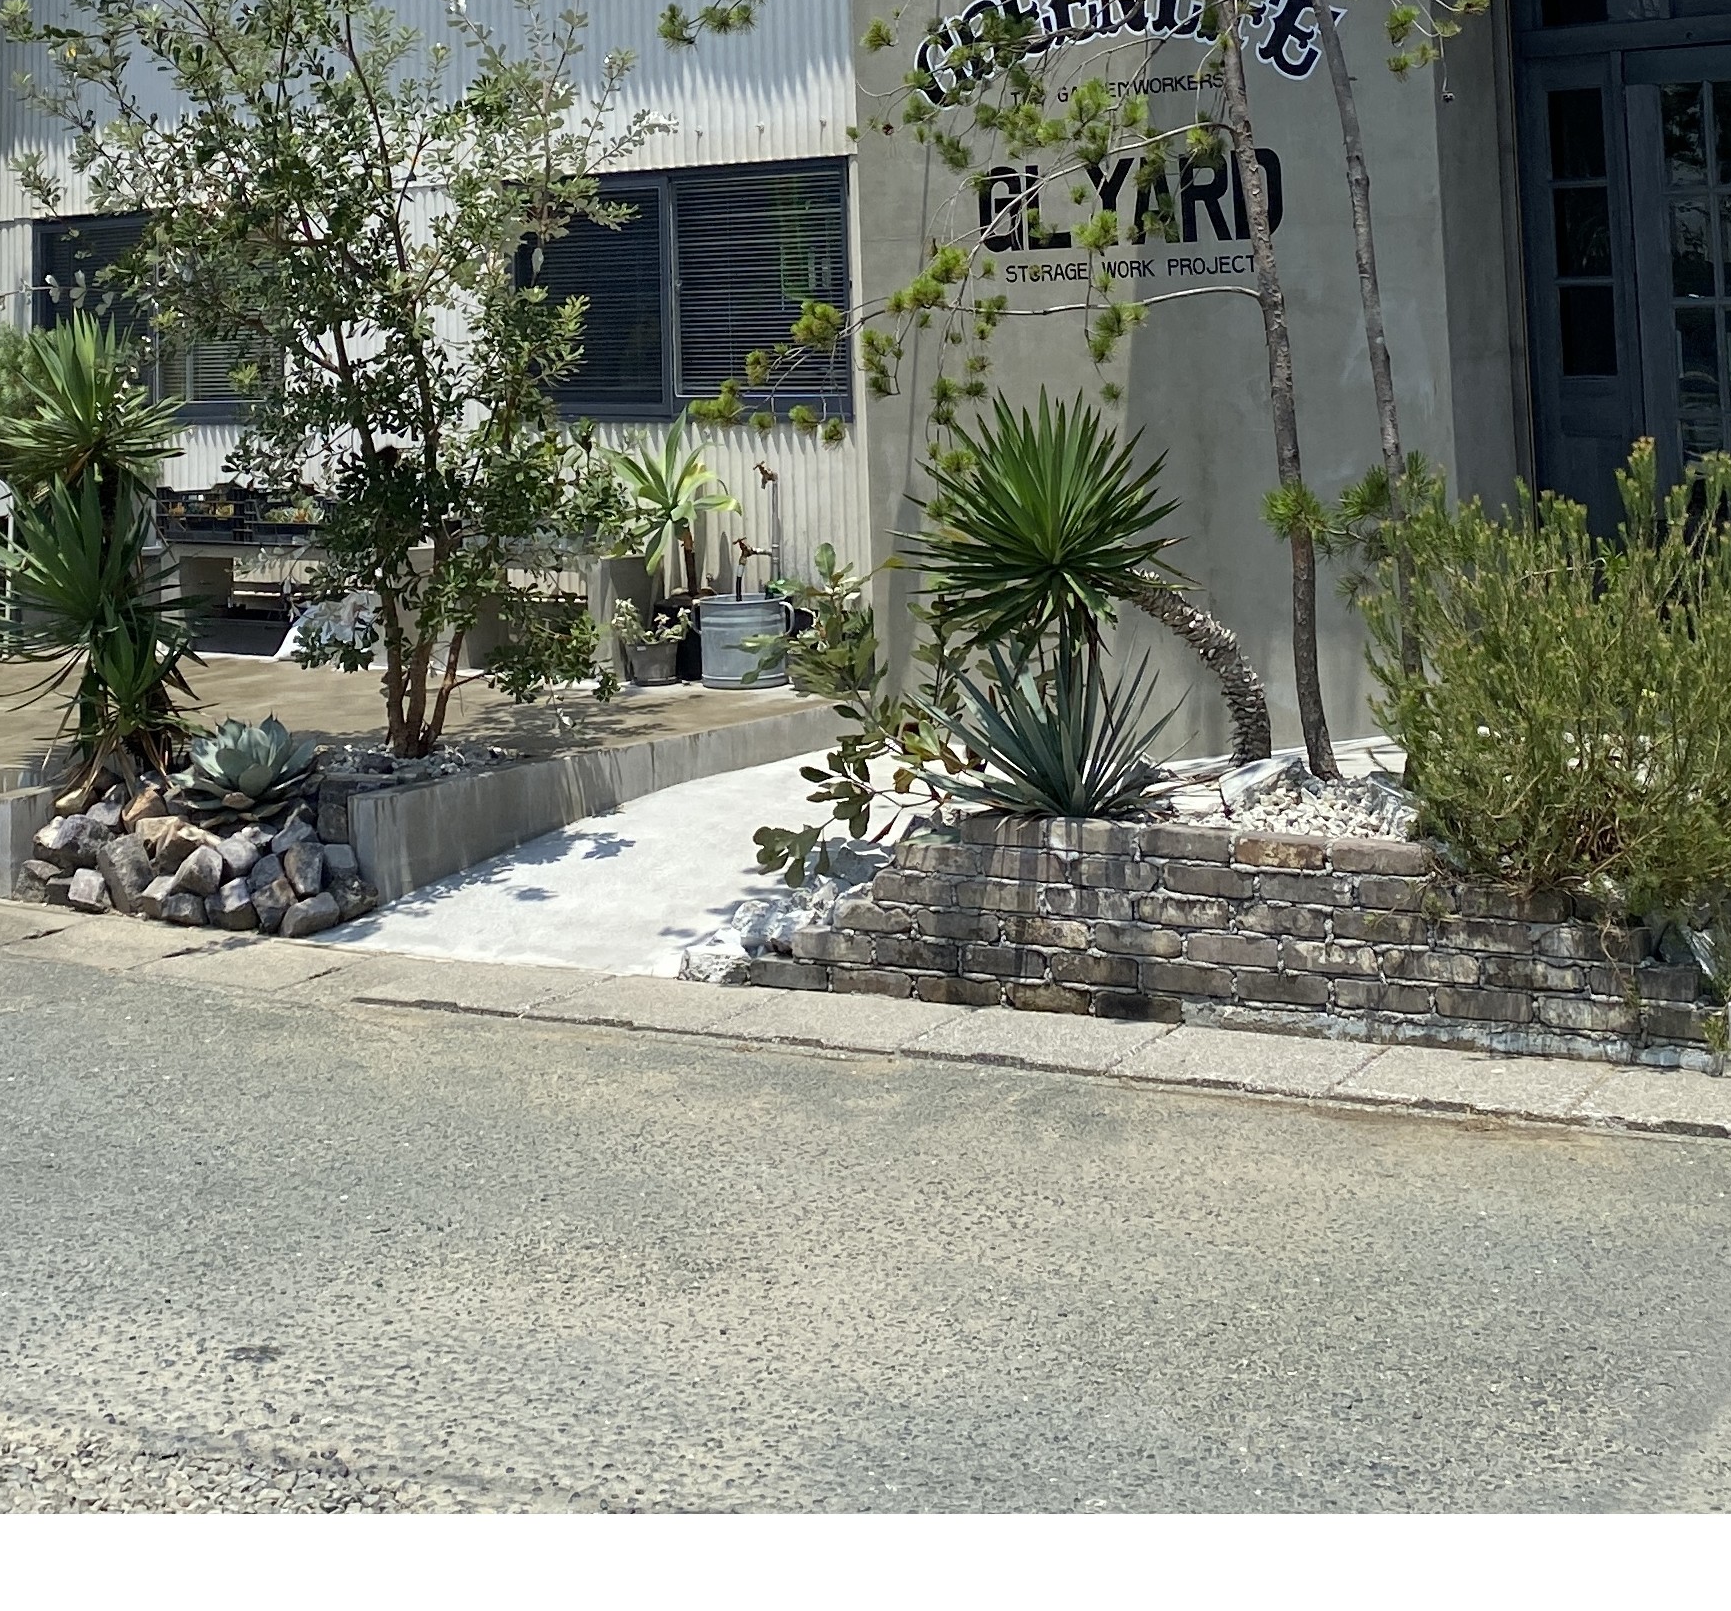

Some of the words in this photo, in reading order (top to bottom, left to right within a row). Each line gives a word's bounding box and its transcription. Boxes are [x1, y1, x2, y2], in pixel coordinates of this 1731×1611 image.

[979, 165, 1072, 253] GL
[1084, 148, 1283, 248] YARD
[1006, 263, 1089, 283] STORAGE
[1102, 259, 1155, 279] WORK
[1168, 255, 1255, 276] PROJECT
